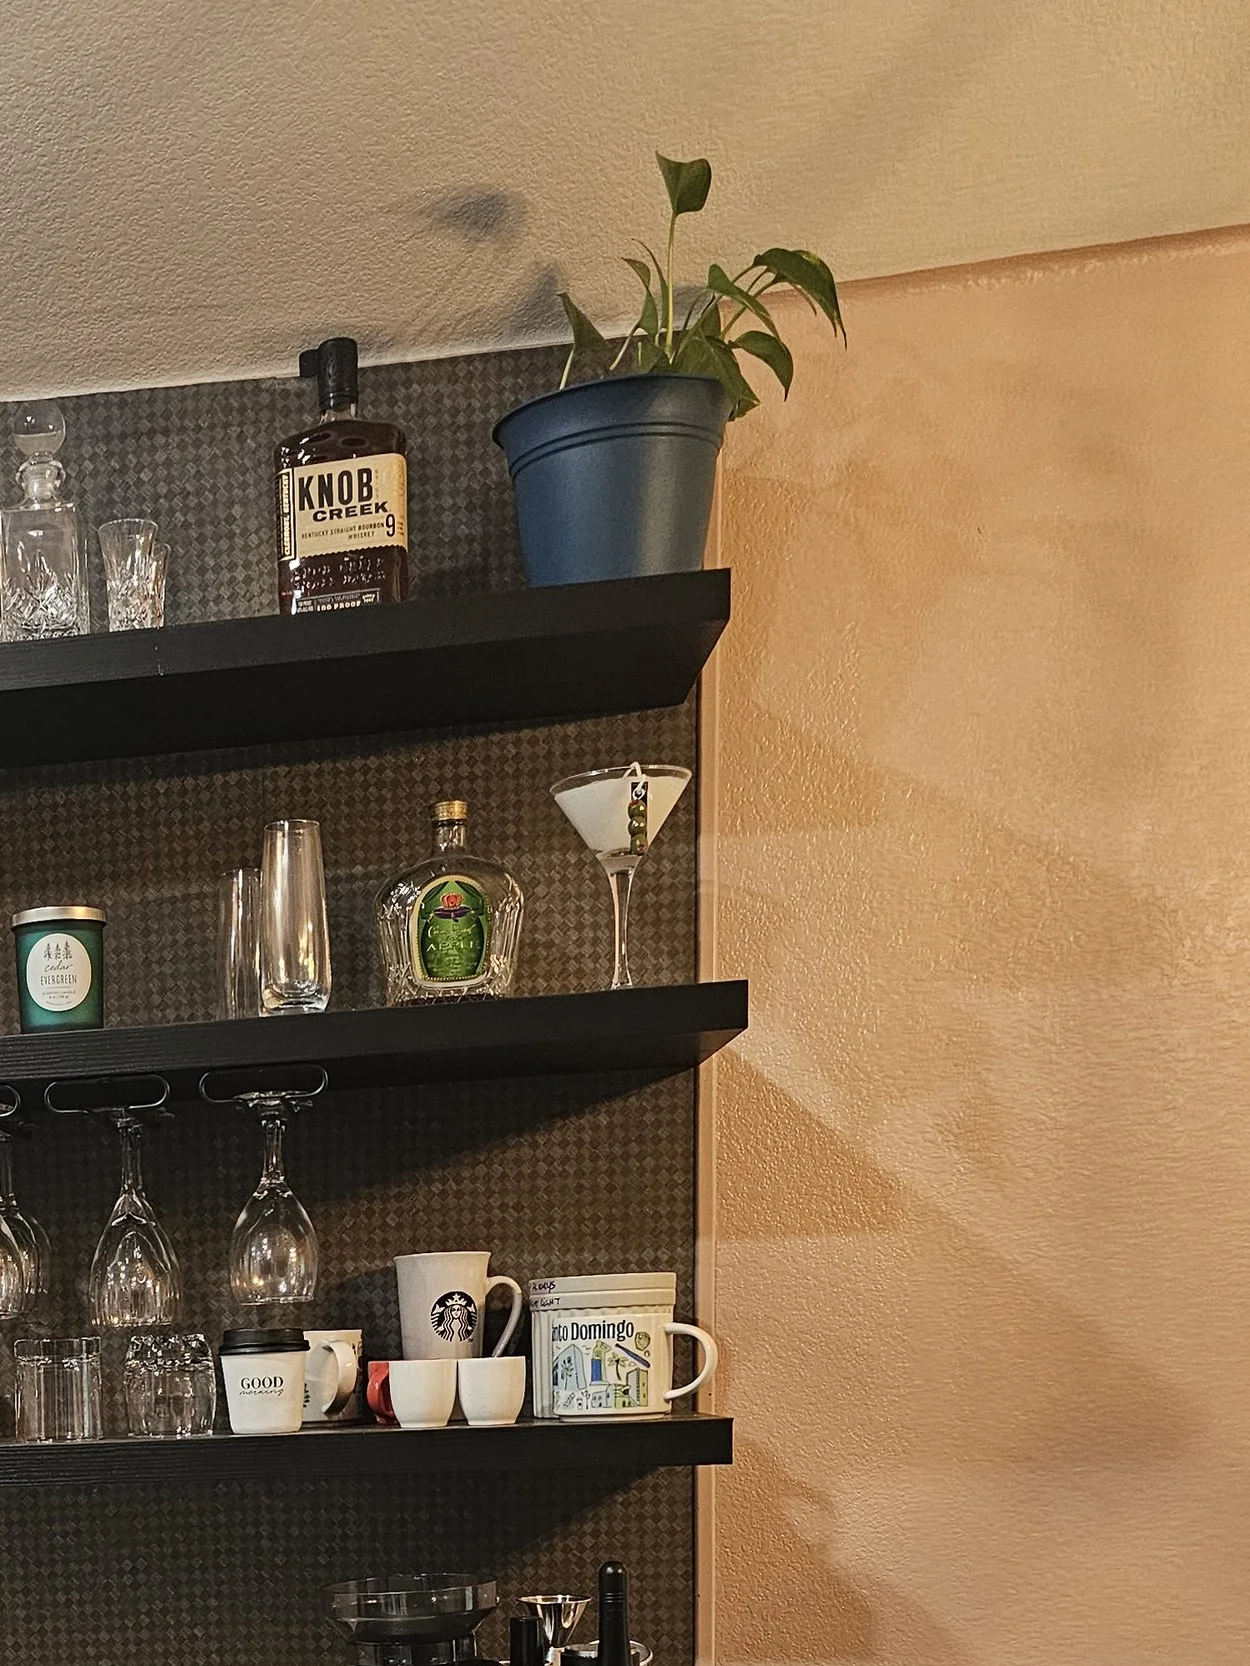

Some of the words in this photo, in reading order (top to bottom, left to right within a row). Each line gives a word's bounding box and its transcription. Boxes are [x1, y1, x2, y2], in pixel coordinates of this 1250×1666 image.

[298, 467, 373, 511] KNOB
[312, 501, 388, 522] CREEK
[301, 531, 329, 539] KENTUCKY
[330, 526, 356, 536] STRAIGHT
[358, 521, 385, 531] BOURBON
[385, 513, 396, 537] 9
[348, 531, 375, 540] WHISKEY
[333, 600, 361, 610] PROOF
[41, 974, 77, 985] EVERGREEN
[571, 1320, 634, 1342] Domingo
[240, 1376, 284, 1390] GOOD
[239, 1388, 284, 1396] morning
